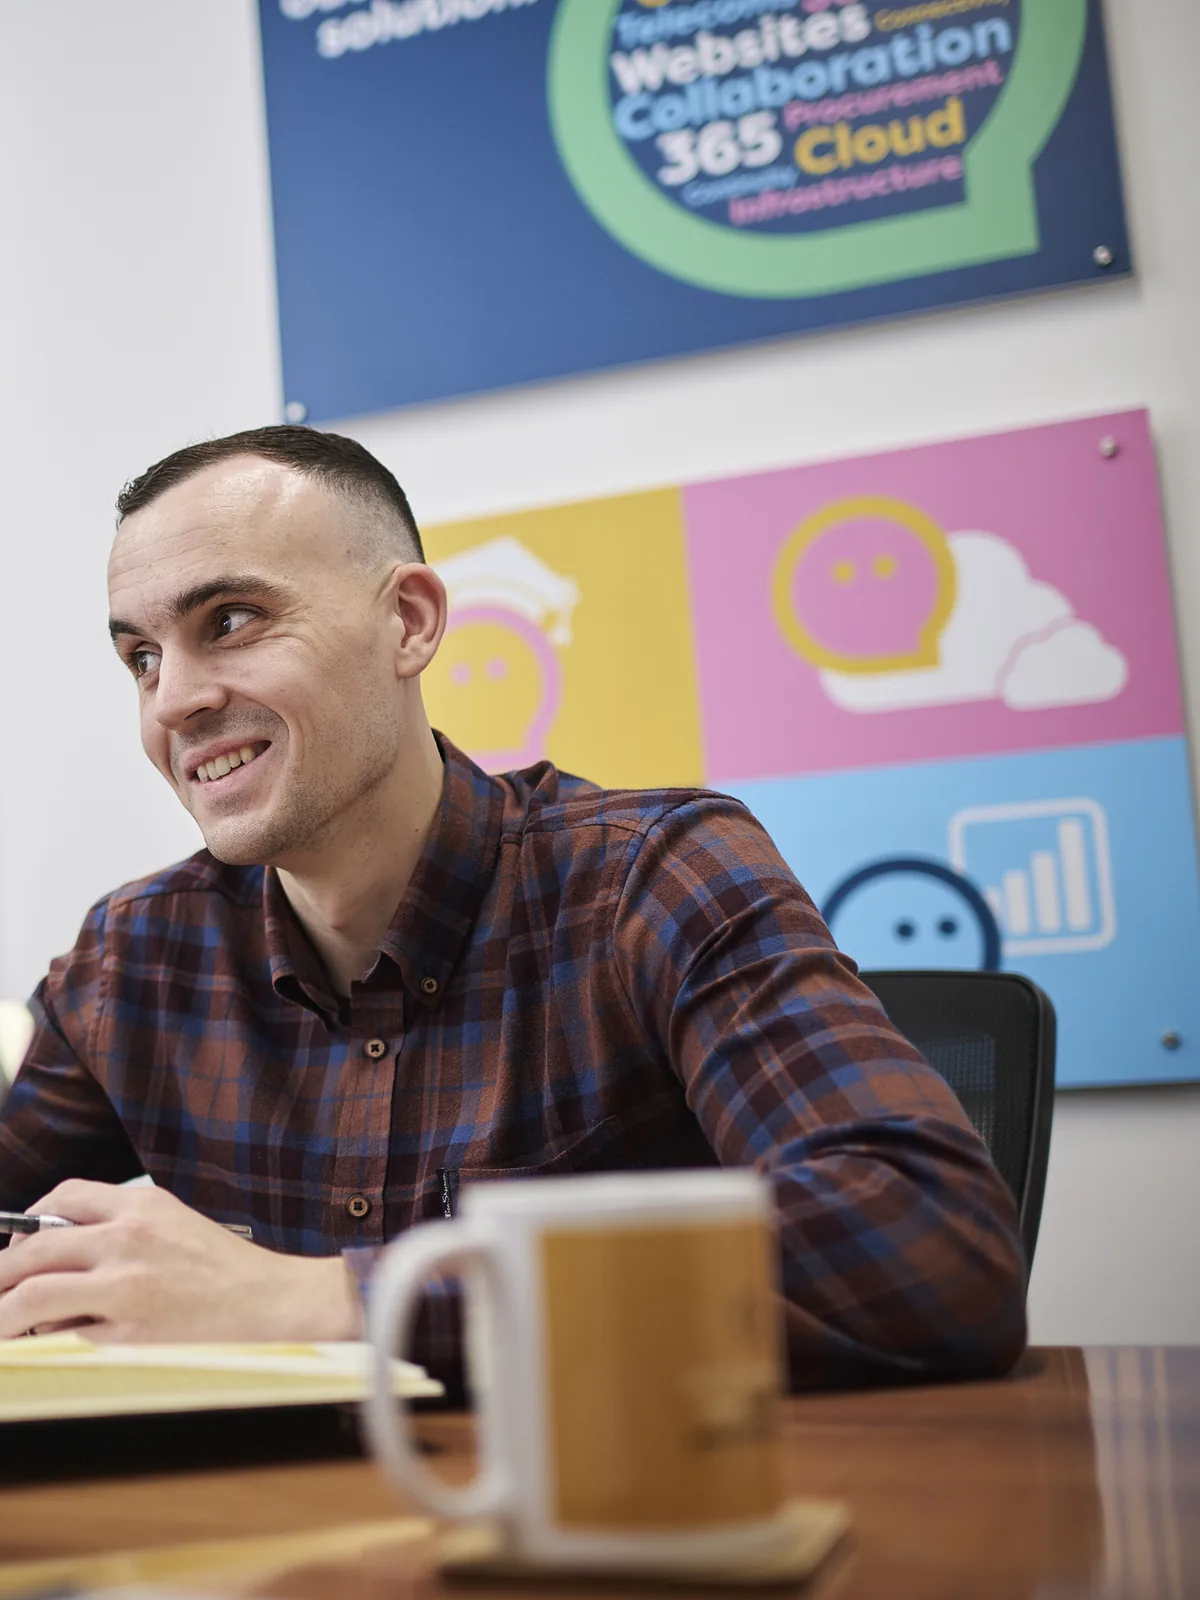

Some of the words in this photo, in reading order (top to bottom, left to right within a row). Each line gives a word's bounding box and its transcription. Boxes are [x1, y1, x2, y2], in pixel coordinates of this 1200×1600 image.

[316, 0, 542, 59] solutio
[611, 3, 871, 94] Websites
[615, 17, 1013, 140] Collaboration
[783, 58, 1003, 132] Procurement
[655, 110, 784, 187] 365
[793, 95, 966, 175] Cloud
[728, 154, 963, 225] Infrastructure
